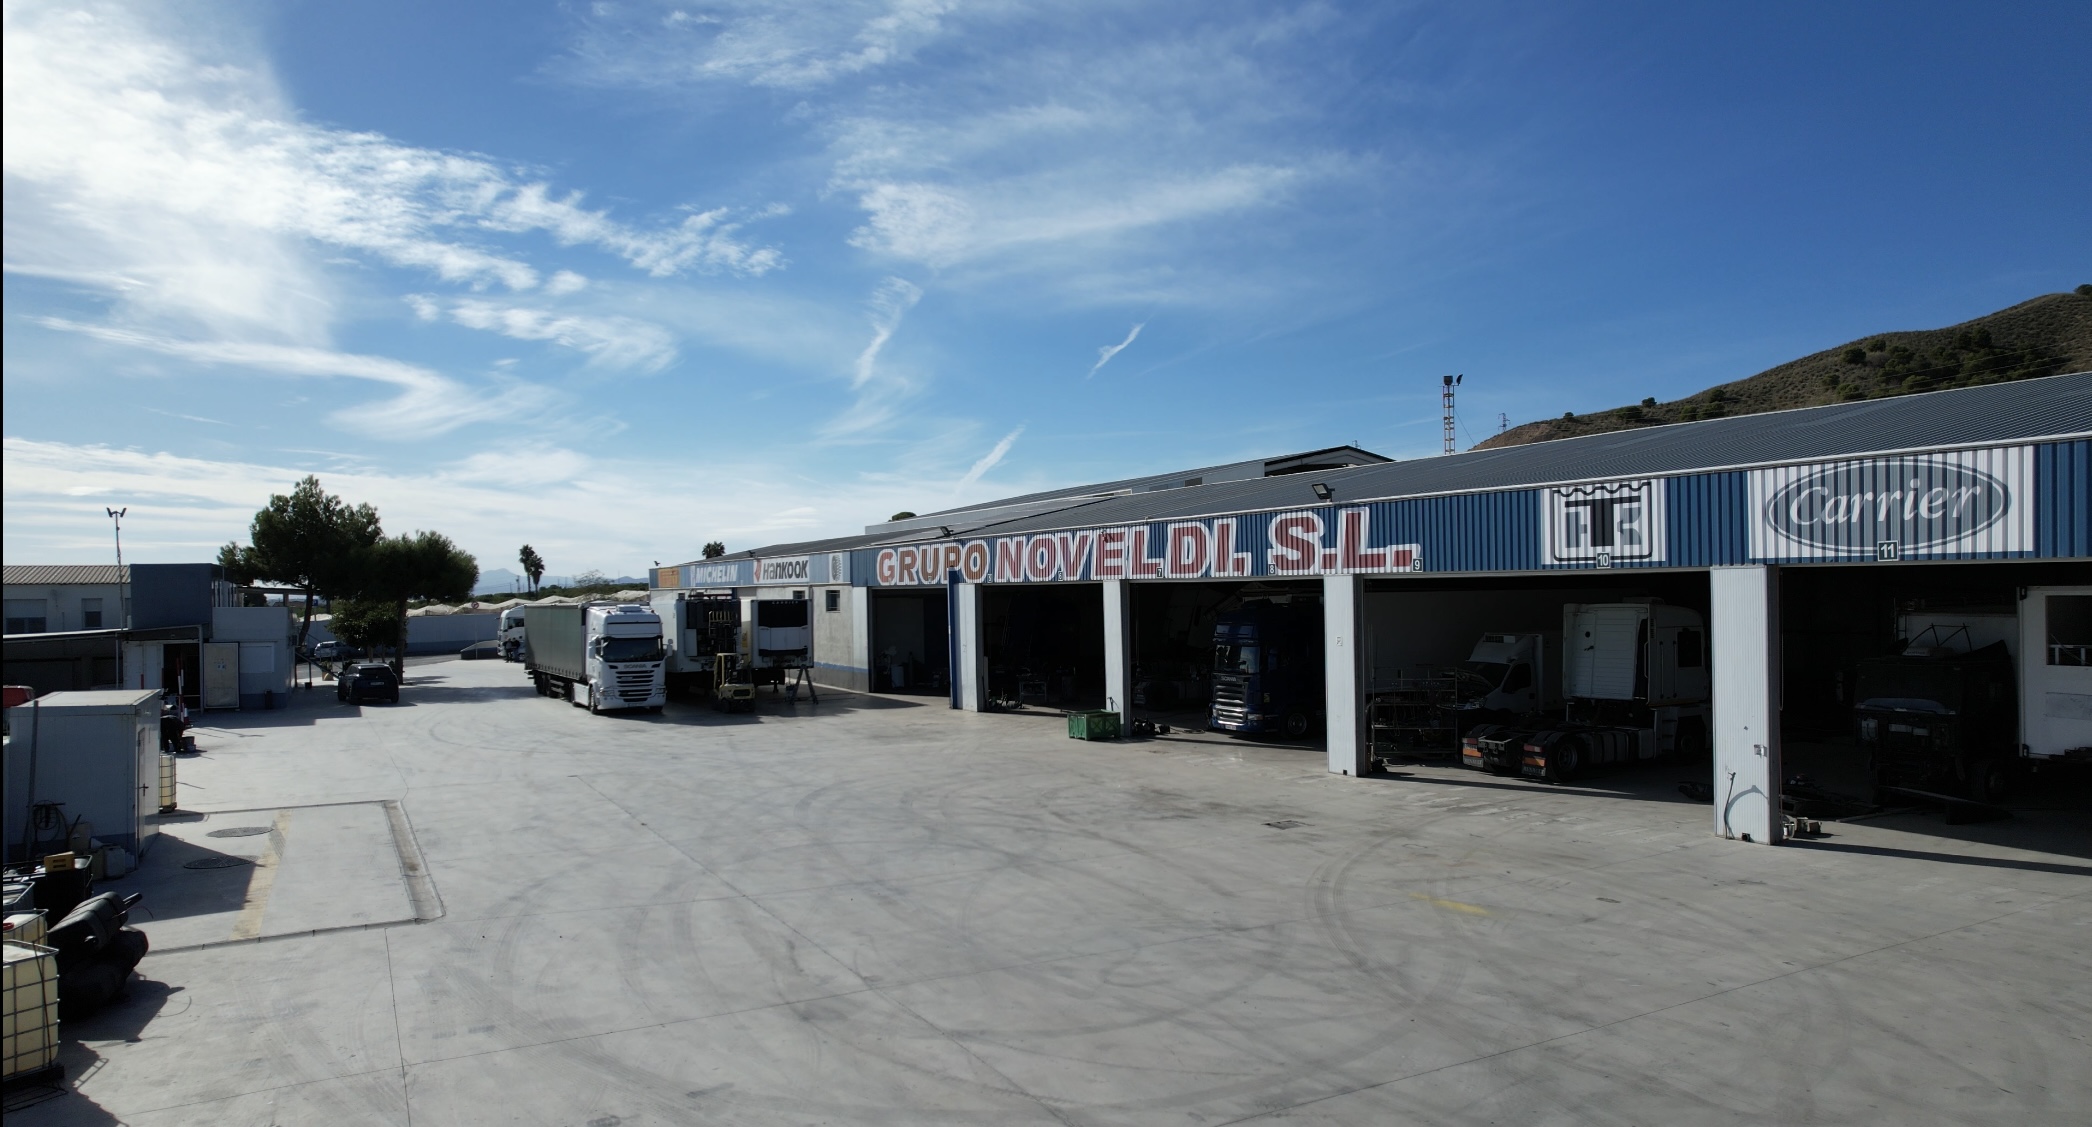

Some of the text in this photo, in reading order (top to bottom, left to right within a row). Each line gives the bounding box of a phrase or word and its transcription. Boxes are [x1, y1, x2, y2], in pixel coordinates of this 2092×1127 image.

[1789, 478, 1982, 526] Carrier
[876, 540, 990, 586] GRUPO
[1267, 507, 1421, 576] S.L.
[1880, 544, 1895, 559] 11
[1597, 553, 1609, 567] 10
[695, 564, 738, 583] MICHELIN
